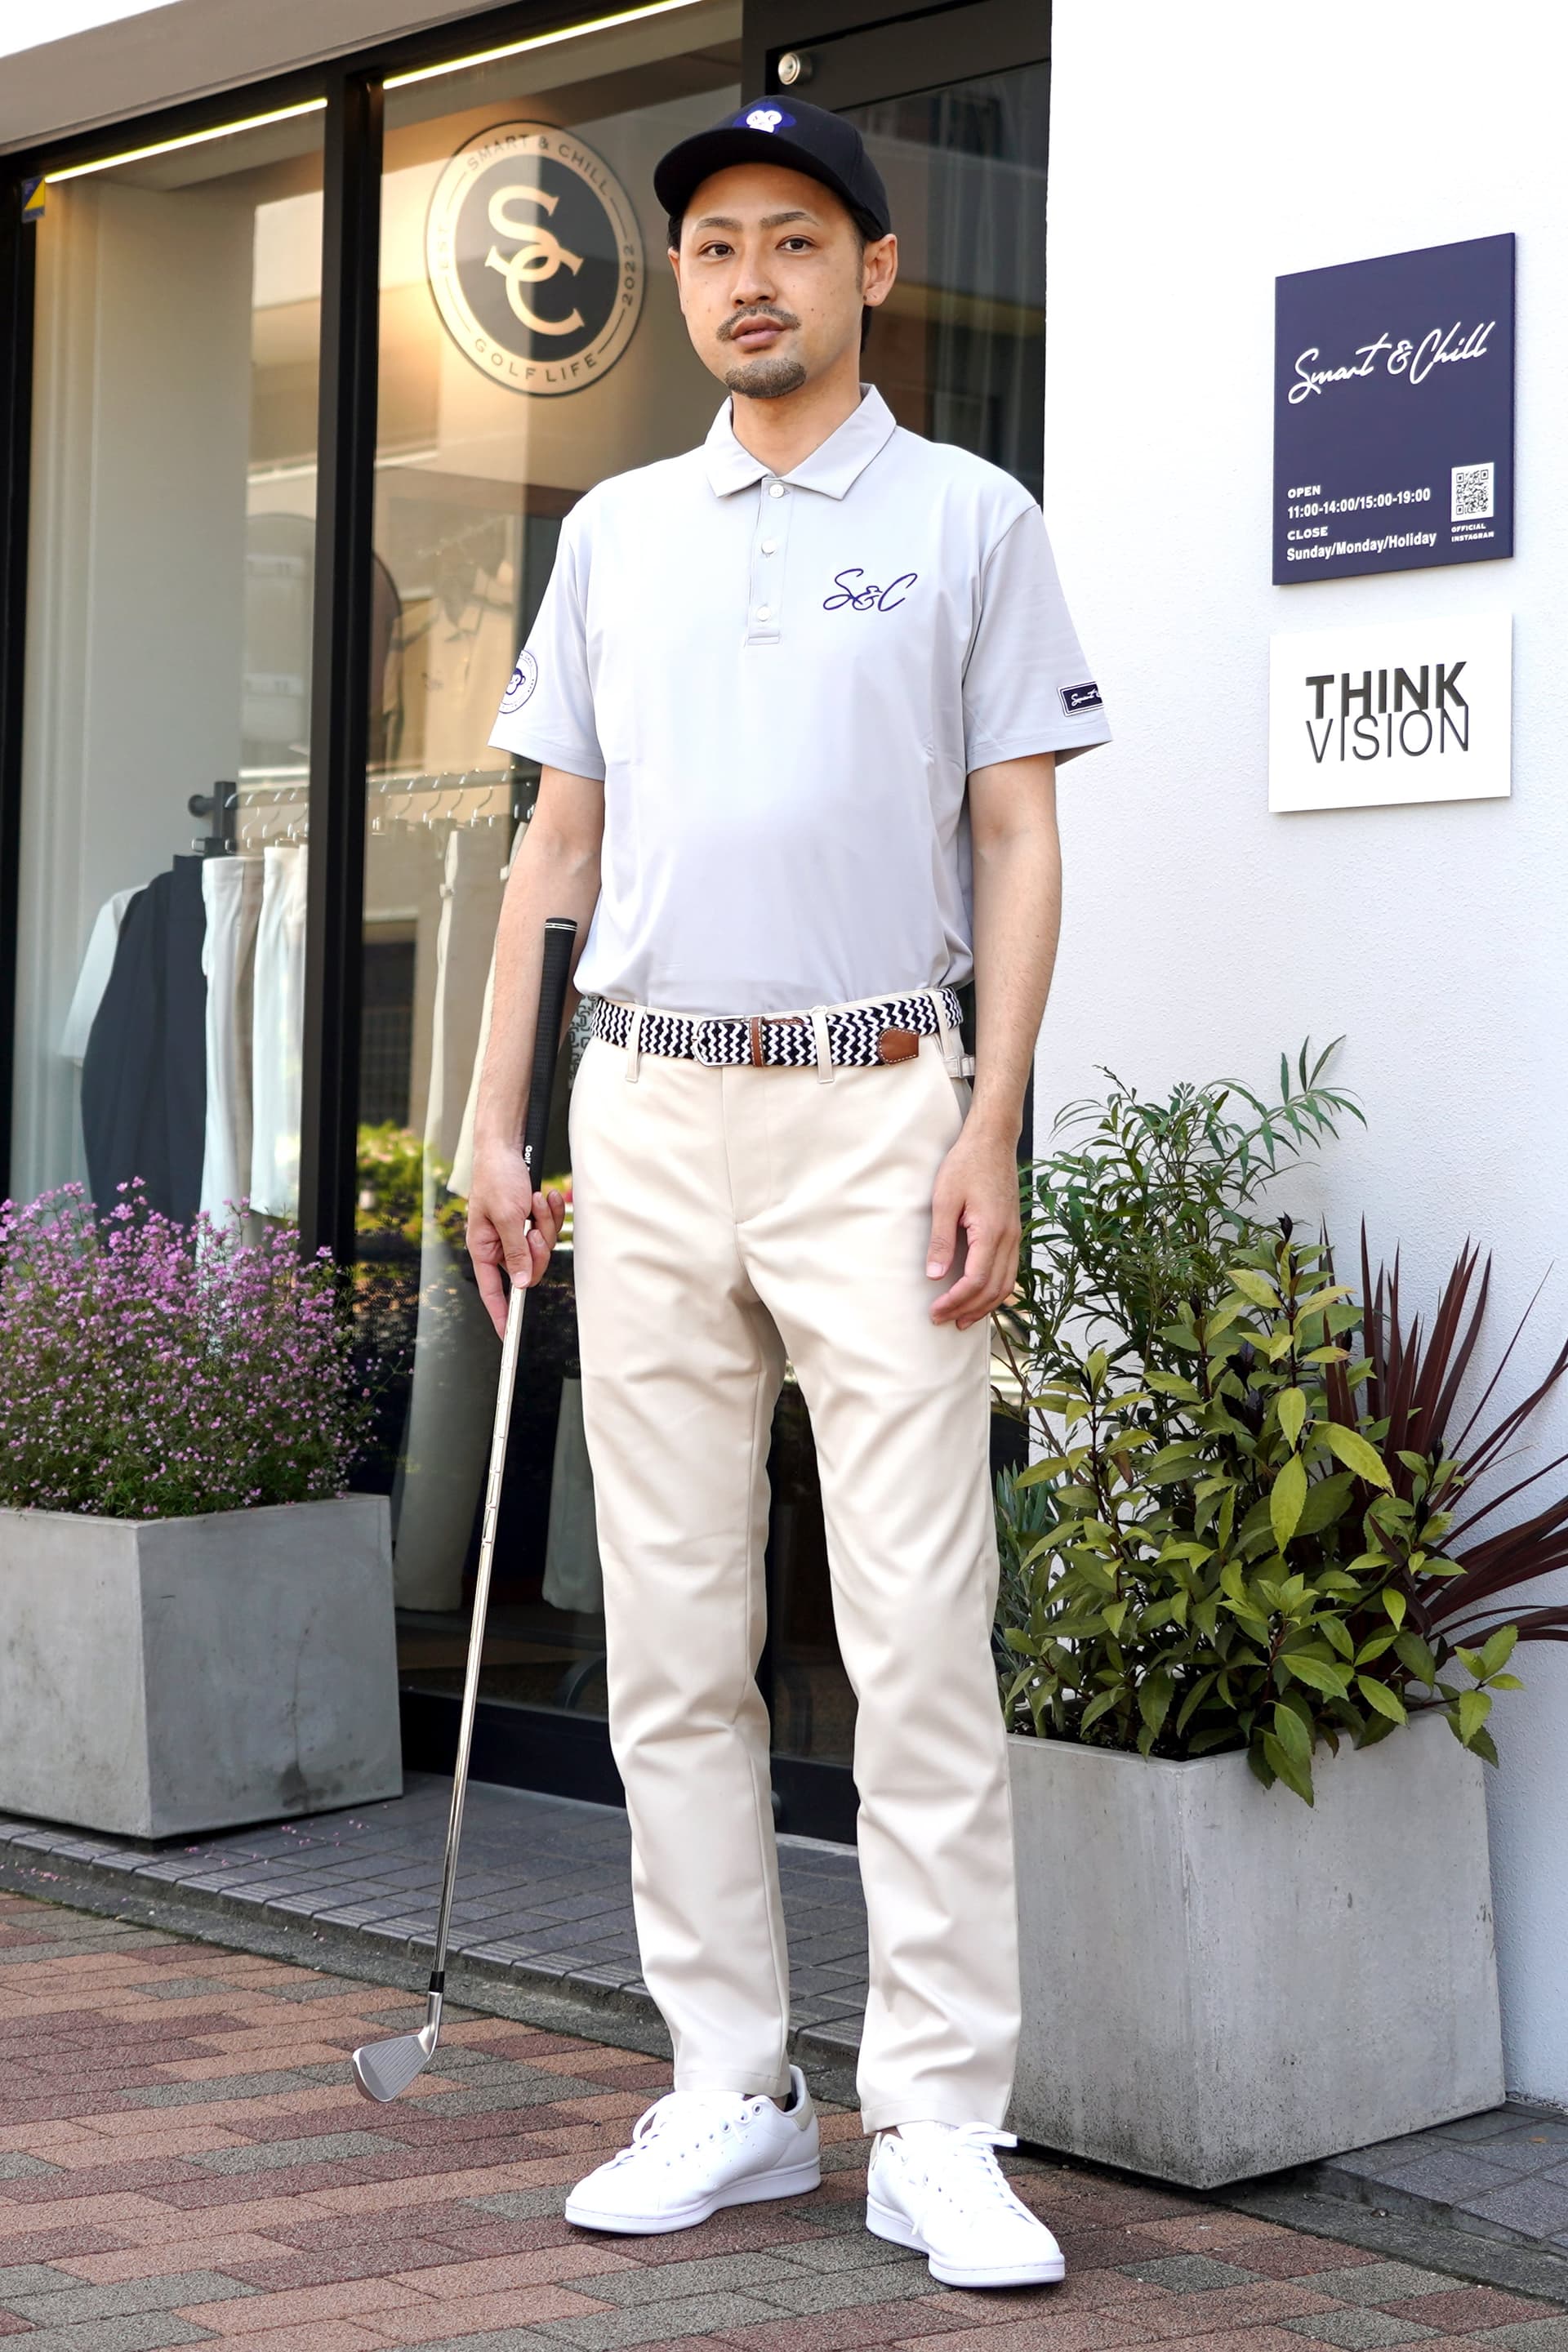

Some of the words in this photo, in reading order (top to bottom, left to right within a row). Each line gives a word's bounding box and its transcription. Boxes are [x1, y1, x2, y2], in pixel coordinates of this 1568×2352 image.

[467, 134, 530, 170] SMART
[539, 136, 549, 150] &
[559, 144, 609, 196] CHILL
[622, 244, 635, 307] 2022
[475, 337, 536, 381] GOLF
[546, 353, 598, 382] LIFE
[1288, 332, 1392, 404] Smart
[1387, 340, 1414, 375] &
[1410, 321, 1496, 385] Chill
[1287, 485, 1321, 499] OPEN
[1286, 532, 1437, 562] Sunday/Monday/Holiday
[1287, 526, 1329, 541] CLOSE
[1450, 523, 1486, 533] OFFICIAL
[1450, 531, 1495, 543] INSTAGRAM
[1305, 661, 1468, 719] THINK
[1305, 706, 1469, 764] VISION
